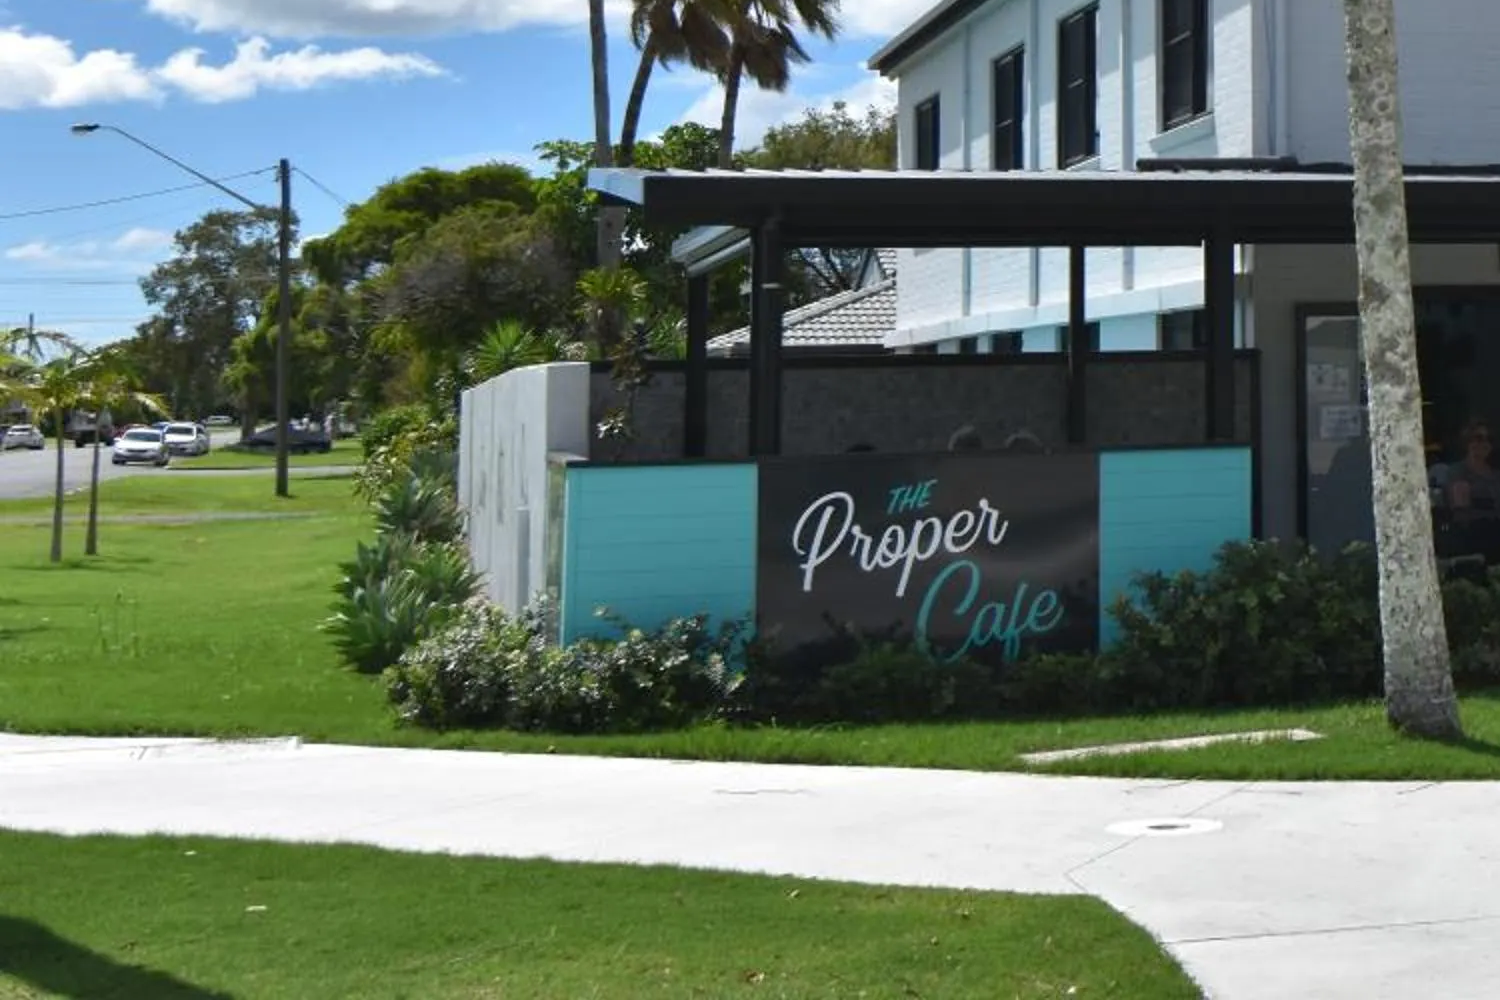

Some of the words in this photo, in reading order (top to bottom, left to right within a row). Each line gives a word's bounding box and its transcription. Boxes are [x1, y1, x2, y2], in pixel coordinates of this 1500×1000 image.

[793, 490, 1009, 598] Proper
[888, 479, 938, 515] THE
[916, 558, 1064, 664] Cafe
